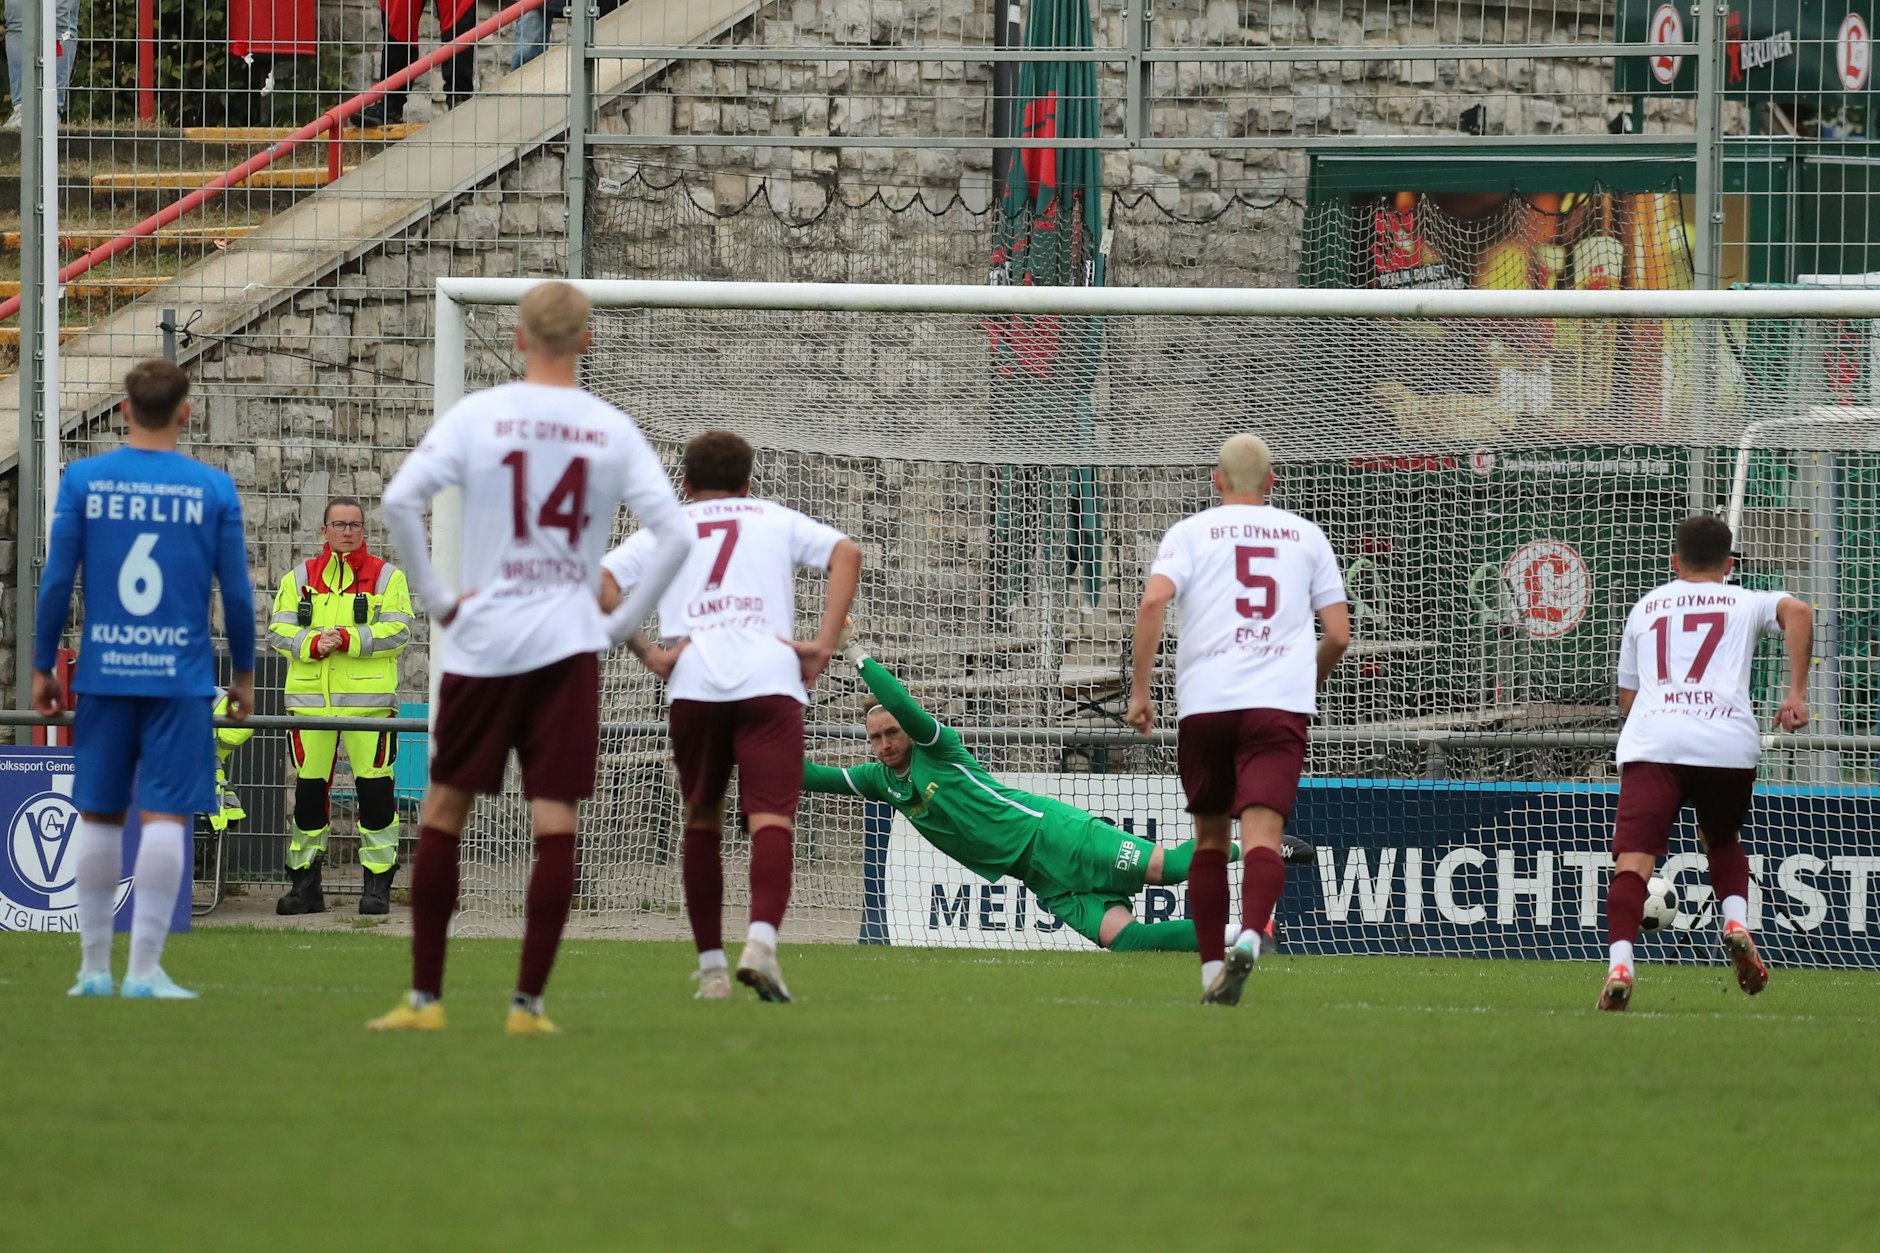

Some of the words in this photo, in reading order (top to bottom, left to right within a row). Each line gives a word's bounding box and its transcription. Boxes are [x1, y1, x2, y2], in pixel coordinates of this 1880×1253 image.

[1741, 30, 1793, 70] BERLINER
[496, 419, 529, 438] BFC
[86, 494, 204, 525] BERLIN
[502, 450, 590, 548] 14
[1210, 526, 1239, 540] BFC
[1243, 524, 1300, 542] DYNAMO
[697, 519, 741, 591] 7
[118, 532, 163, 617] 6
[1235, 545, 1279, 620] 5
[1645, 598, 1671, 614] BFC
[1676, 594, 1736, 607] DYNAMO
[91, 623, 189, 647] KUJOVIC
[1649, 611, 1728, 686] 17
[101, 650, 176, 667] structure
[1664, 691, 1714, 705] MEYER
[0, 760, 44, 773] olkssport
[1316, 844, 1713, 930] WICHTG
